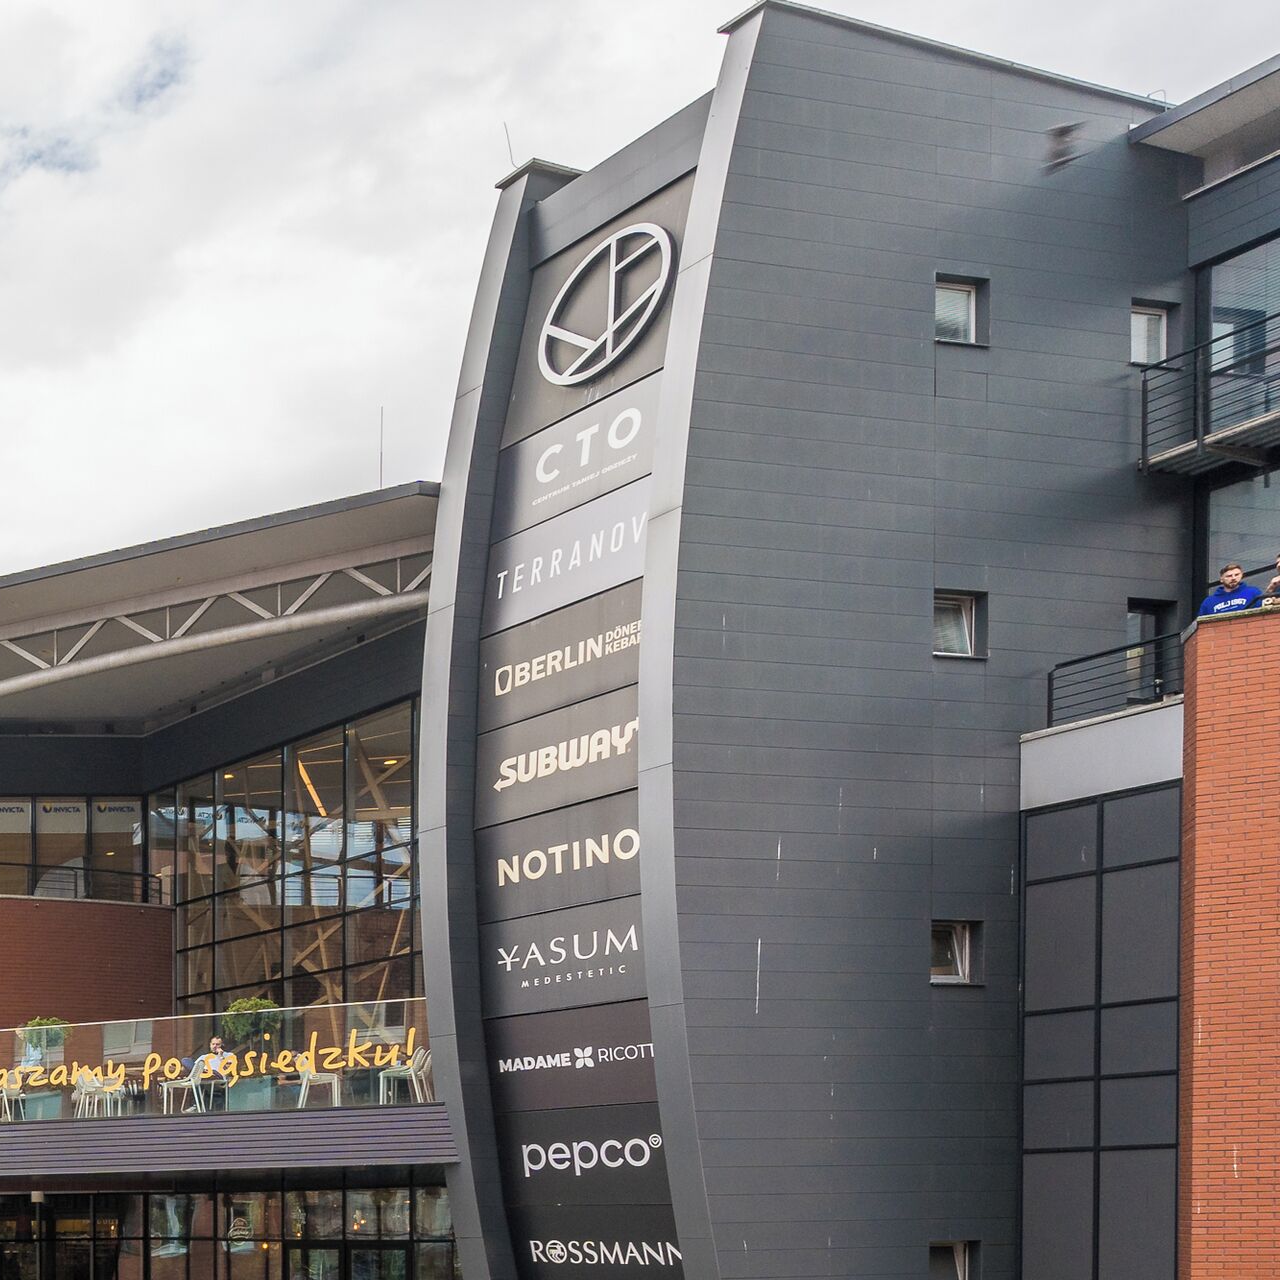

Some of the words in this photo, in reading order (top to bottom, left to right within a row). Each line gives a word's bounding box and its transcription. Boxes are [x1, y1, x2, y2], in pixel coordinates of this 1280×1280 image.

[535, 407, 642, 483] CTO
[532, 484, 570, 506] CENTRUM
[572, 471, 600, 488] TANIEJ
[496, 511, 648, 600] TERRANOV
[514, 634, 603, 687] BERLIN
[493, 717, 639, 793] SUBWAY
[53, 806, 81, 814] INVICTA
[107, 805, 135, 813] INVICTA
[497, 828, 640, 887] NOTINO
[498, 925, 639, 972] YASUM
[521, 965, 627, 988] MEDESTETIC
[142, 1053, 182, 1091] po
[202, 1027, 417, 1088] sąsiedzku!
[499, 1052, 571, 1073] MADAME
[522, 1138, 651, 1177] pepco
[529, 1240, 682, 1266] ROSSMANN
